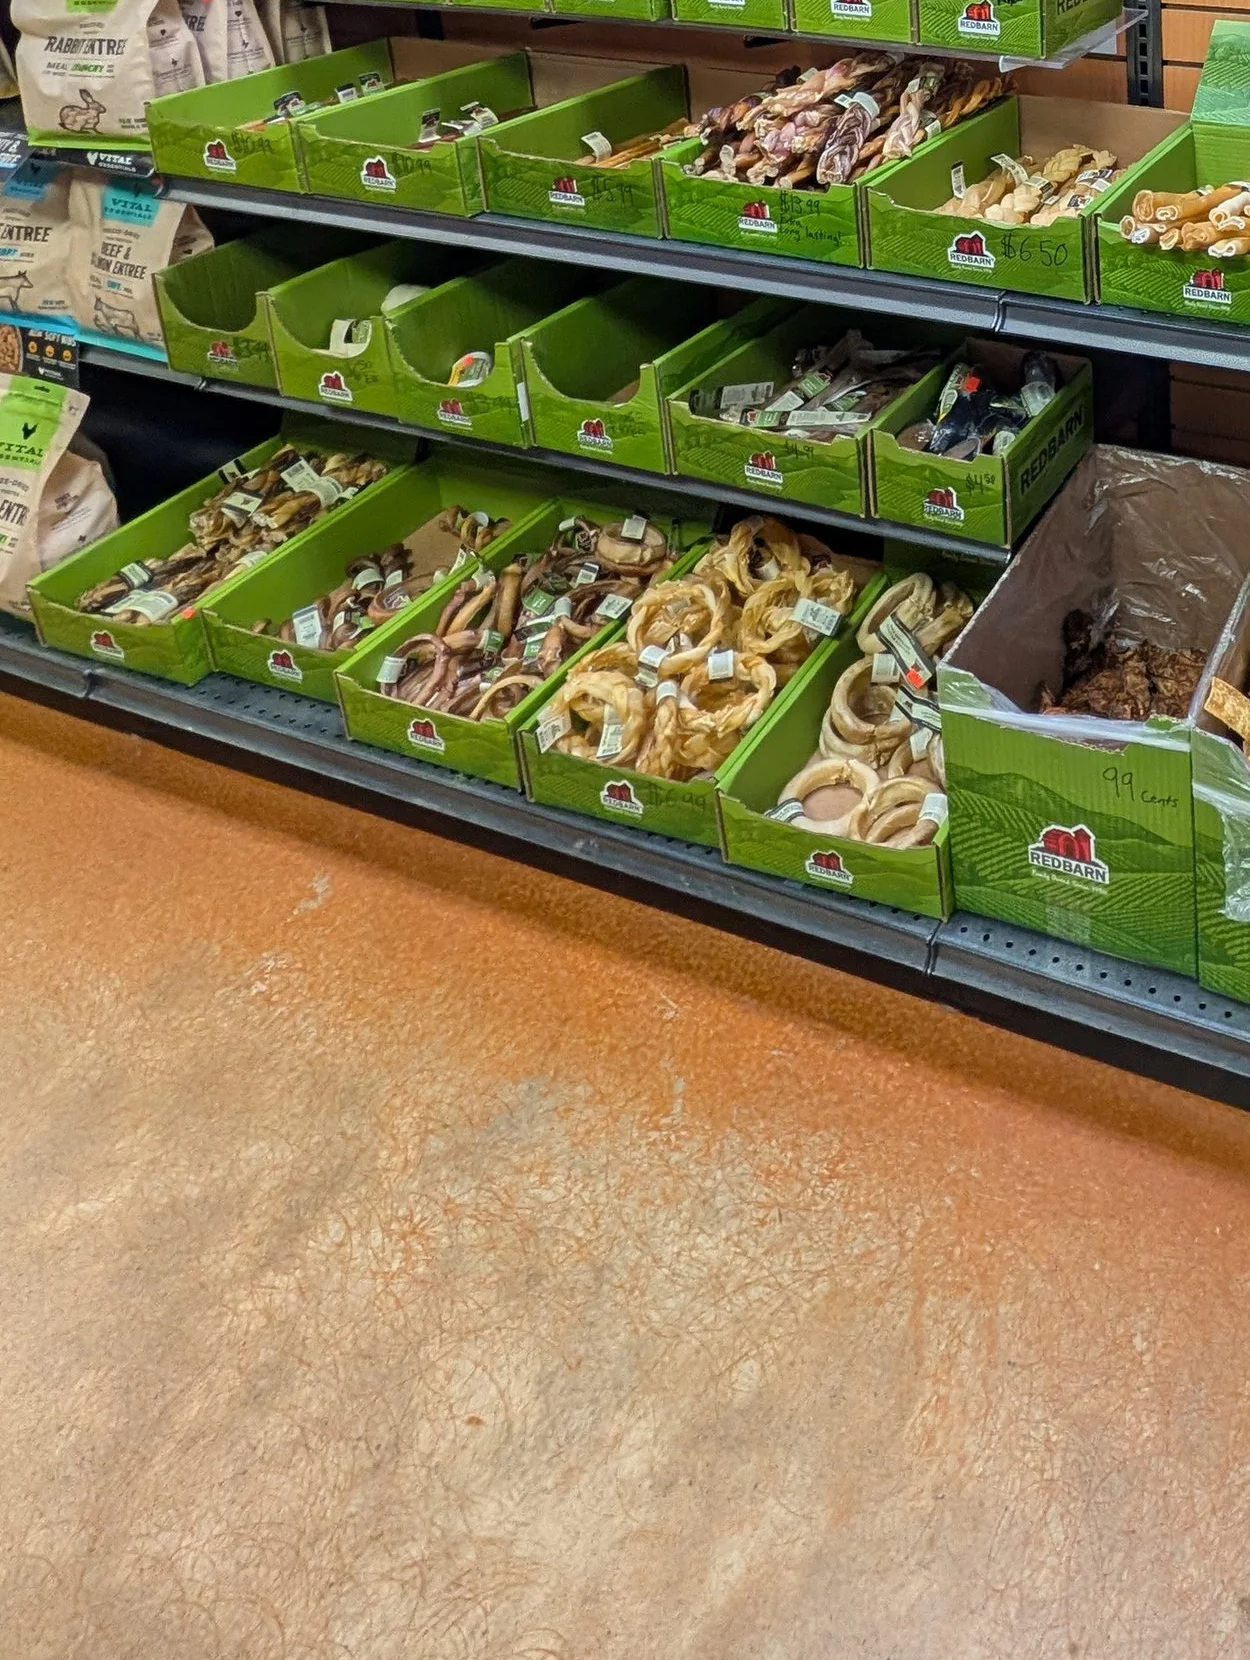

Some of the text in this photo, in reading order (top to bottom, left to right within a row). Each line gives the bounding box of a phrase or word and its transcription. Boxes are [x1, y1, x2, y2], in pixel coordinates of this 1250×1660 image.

[960, 20, 998, 31] REDBARN
[99, 154, 132, 165] VITAL
[111, 197, 152, 212] VITAL
[951, 253, 994, 266] REDBARN
[1184, 289, 1230, 304] REDBARN
[1019, 405, 1085, 494] REDBARN
[1102, 767, 1135, 802] 99
[1030, 850, 1107, 882] REDBARN
